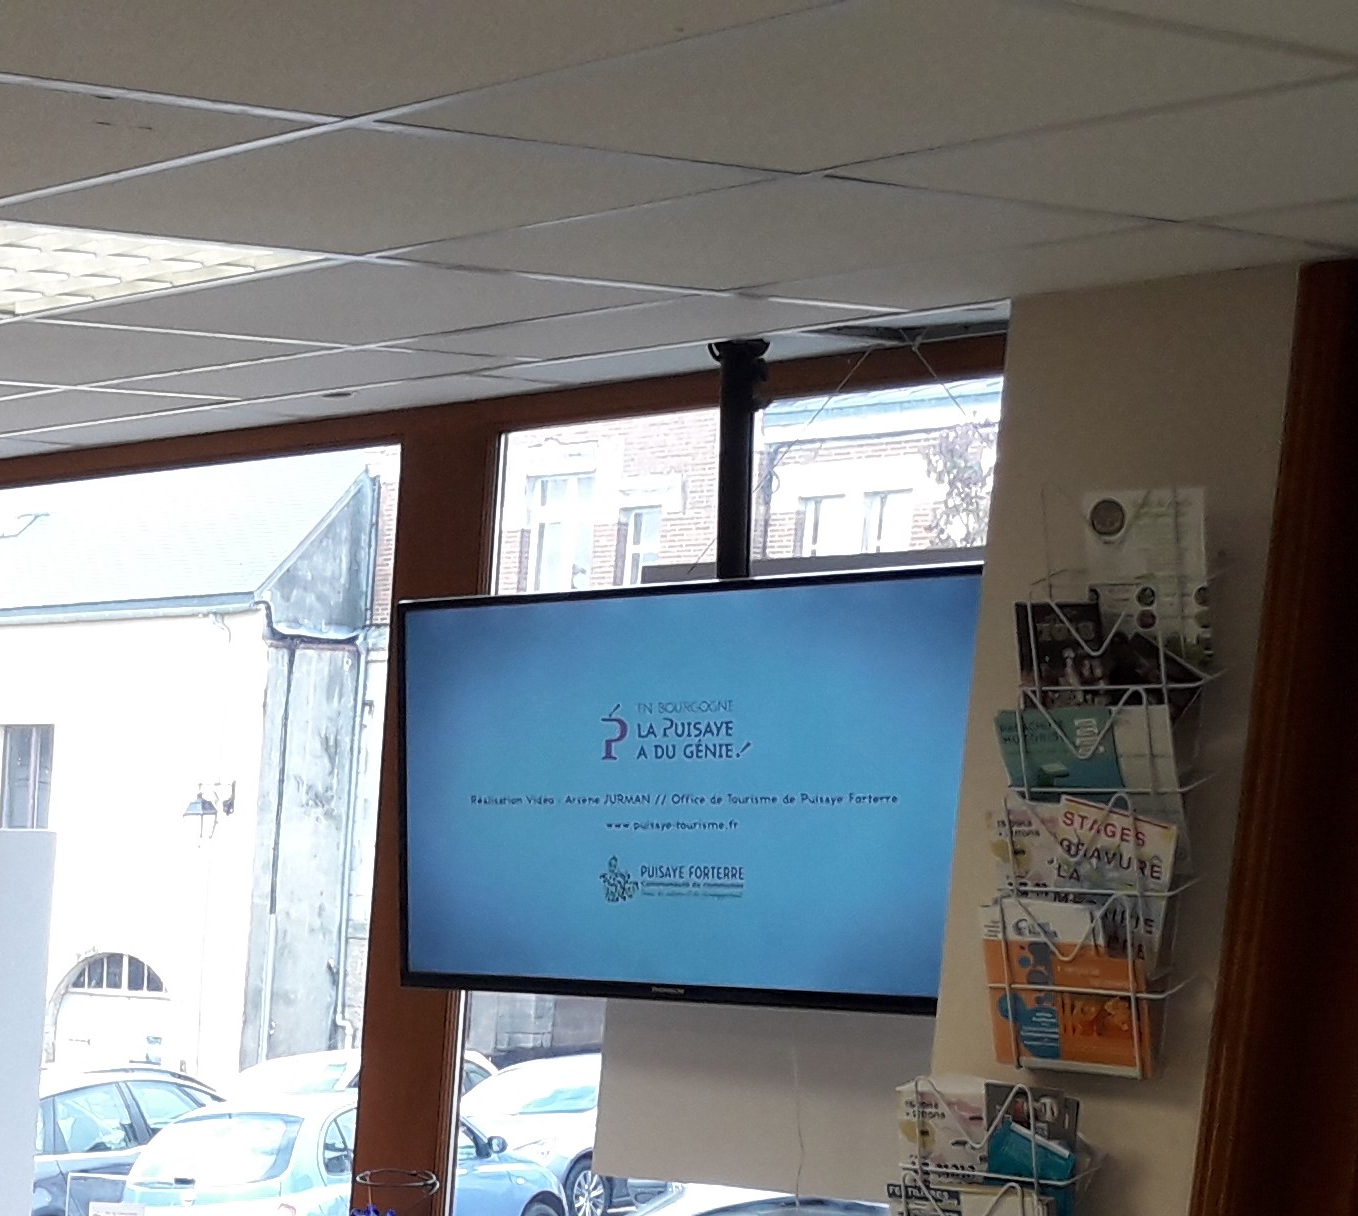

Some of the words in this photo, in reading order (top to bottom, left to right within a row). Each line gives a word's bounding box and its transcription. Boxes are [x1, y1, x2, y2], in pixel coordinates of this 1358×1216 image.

[658, 699, 734, 714] BOURGOGNE
[637, 722, 658, 740] LA
[662, 718, 734, 739] PUISAYE
[636, 745, 648, 760] A
[653, 744, 676, 760] DU
[604, 793, 651, 806] JURMAN
[671, 793, 706, 806] Office
[710, 793, 723, 805] de
[727, 793, 778, 805] Tourisme
[782, 793, 796, 805] de
[800, 793, 843, 807] Puisaye
[848, 792, 899, 804] Forterre
[640, 864, 686, 880] PUISAYE
[688, 865, 745, 881] FORTERRE
